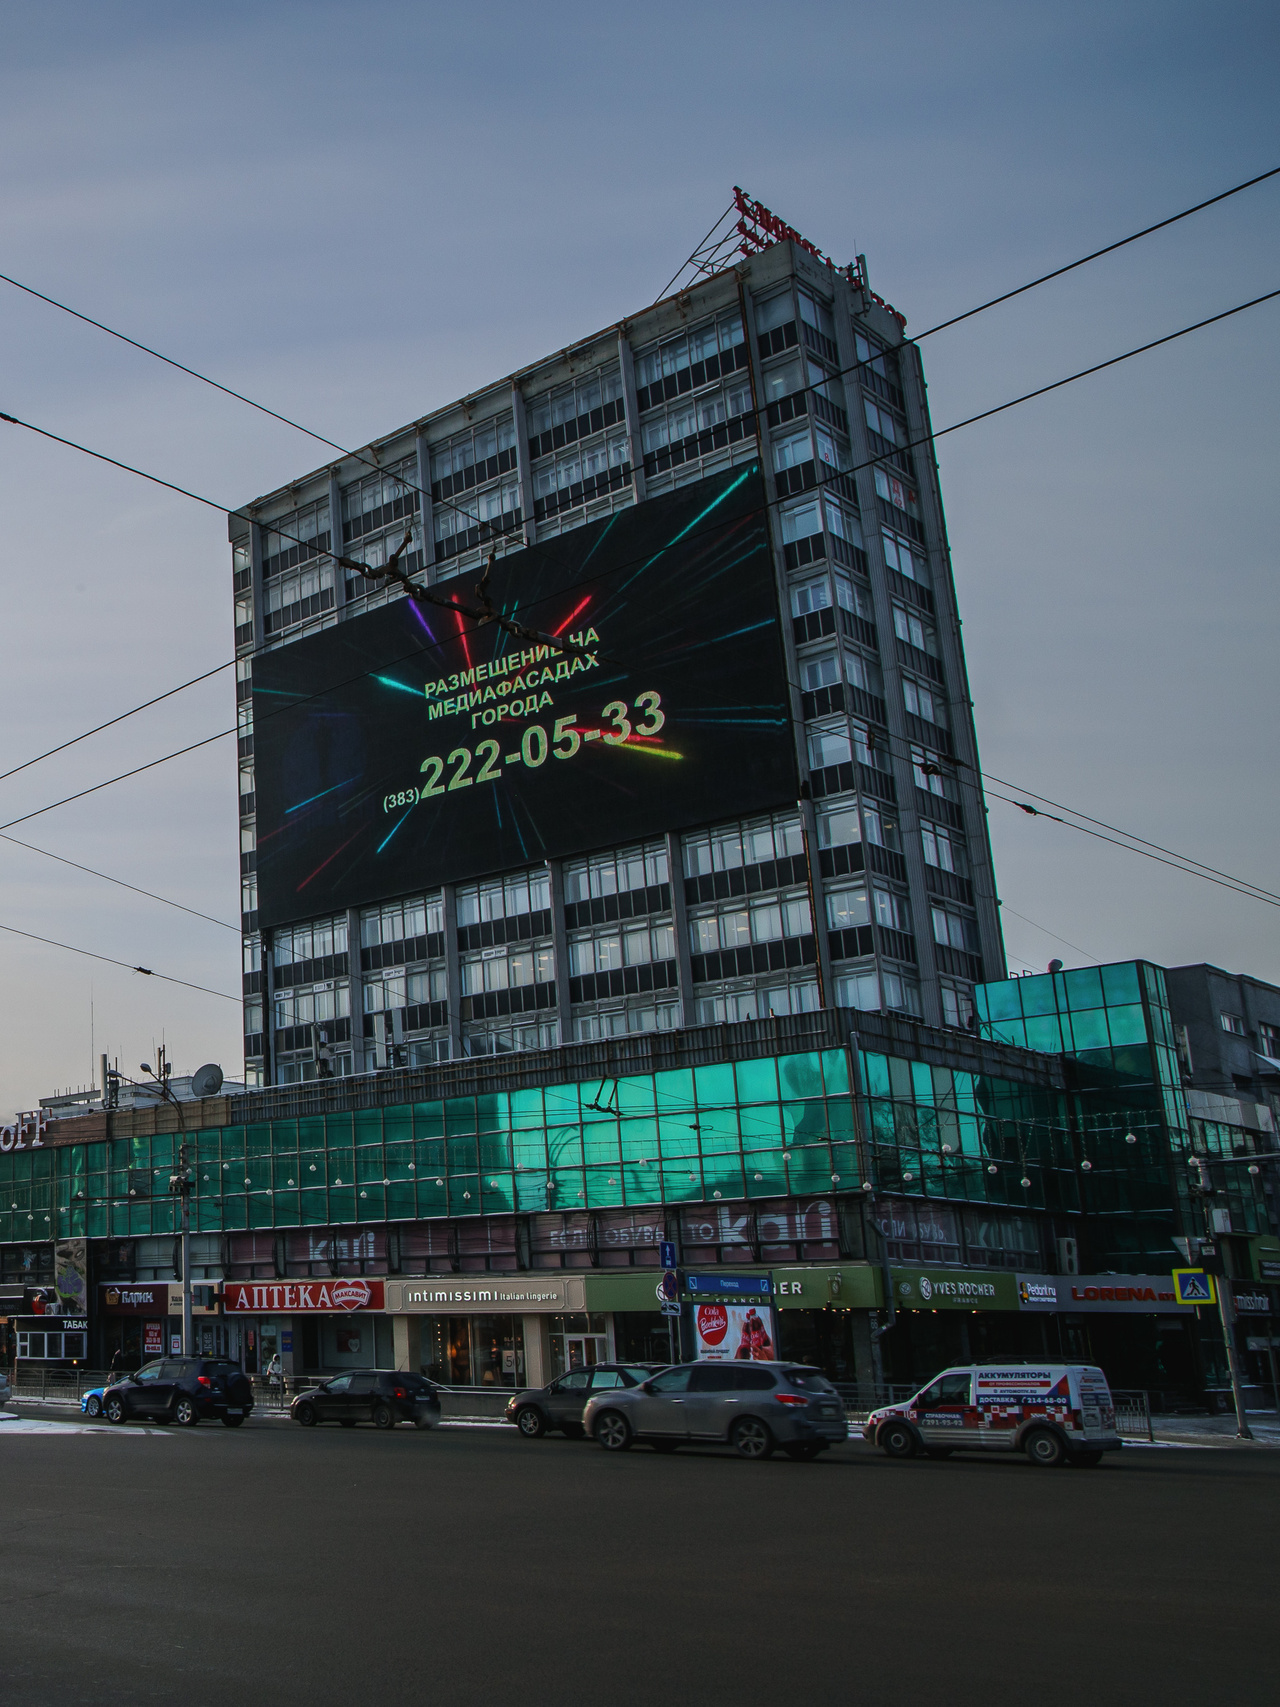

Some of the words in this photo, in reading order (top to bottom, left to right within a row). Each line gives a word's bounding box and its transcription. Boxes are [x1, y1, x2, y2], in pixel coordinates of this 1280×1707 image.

[424, 645, 564, 699] РАЗМЕЩЕНИЕ
[428, 651, 600, 721] МЕДИАФАСАДАХ
[471, 691, 554, 730] ГОРОДА
[382, 787, 420, 813] (383)
[419, 690, 666, 800] 222-05-33
[720, 1200, 833, 1252] kari
[235, 1285, 333, 1309] АПТЕКА
[334, 1292, 367, 1301] МАКСАВИТ
[408, 1289, 498, 1302] intimissimi
[500, 1292, 525, 1301] Italian
[526, 1291, 557, 1302] lingerie
[932, 1281, 956, 1295] YVES
[957, 1281, 996, 1297] ROCHER
[1071, 1286, 1157, 1301] LORENA
[704, 1307, 719, 1316] Cola
[62, 1320, 89, 1330] ТАБАК
[978, 1397, 1017, 1405] ДОСТАВКА:
